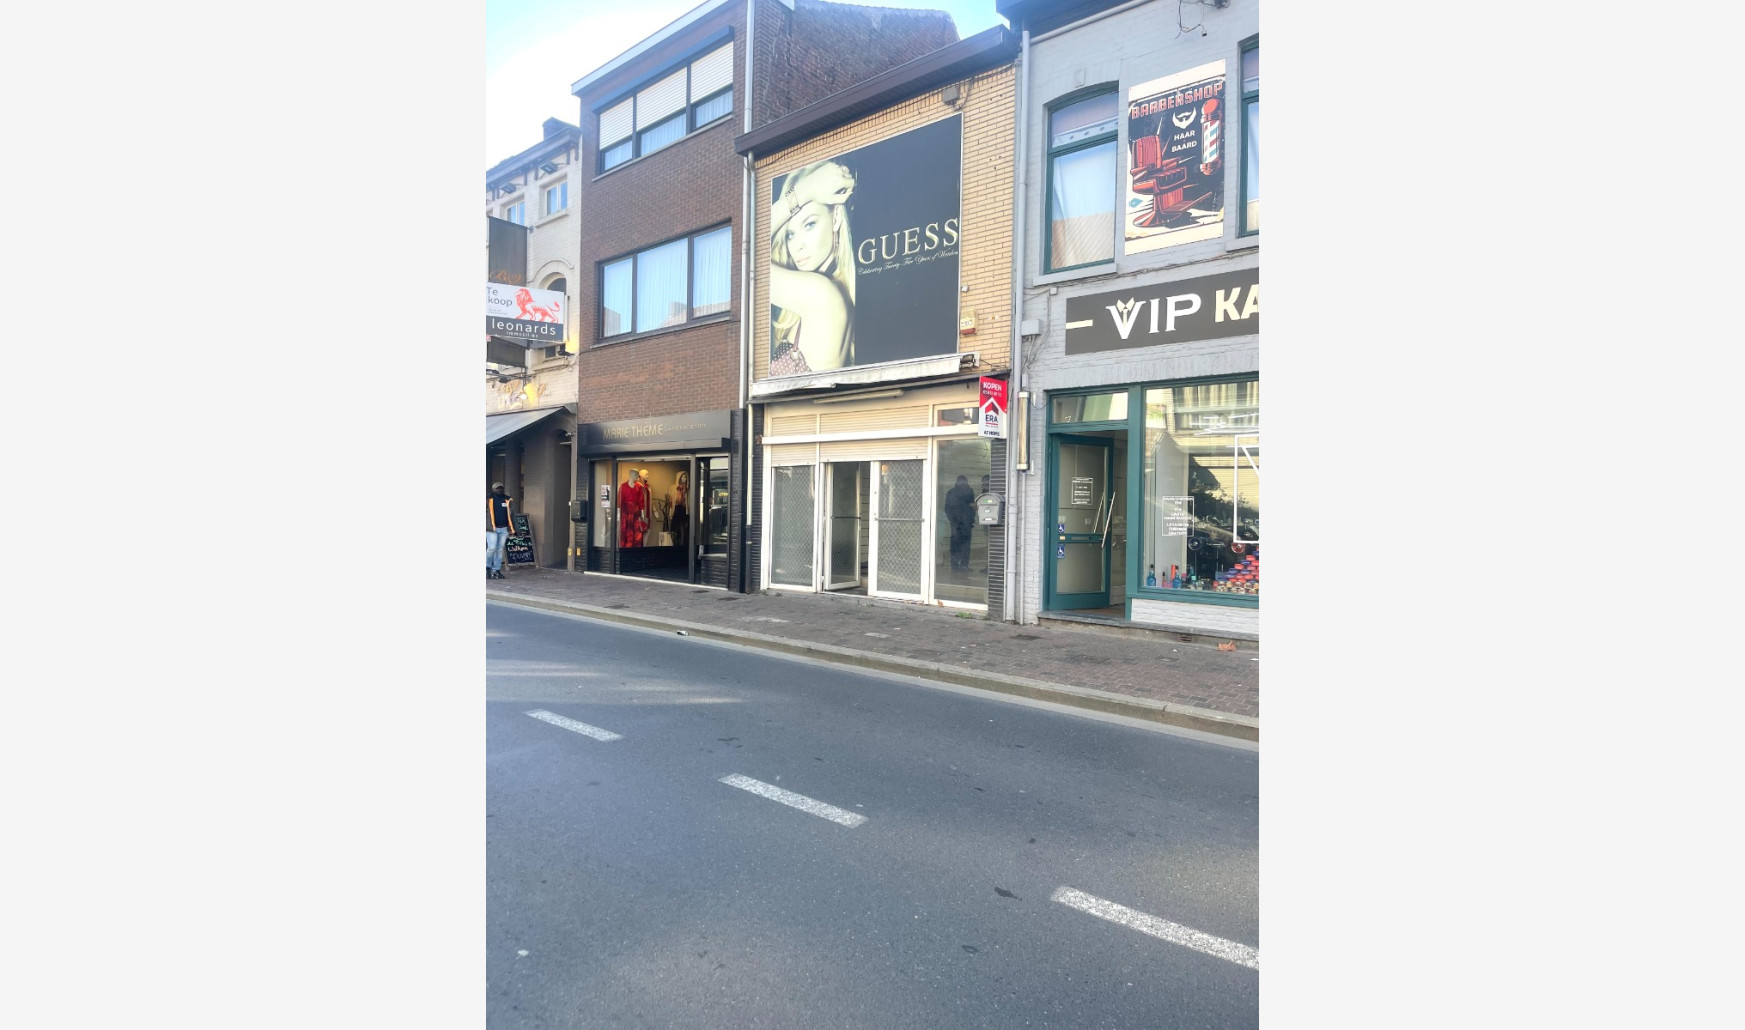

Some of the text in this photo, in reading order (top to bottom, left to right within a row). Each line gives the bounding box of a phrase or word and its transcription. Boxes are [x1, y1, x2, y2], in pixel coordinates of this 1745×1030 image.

[1131, 82, 1223, 120] BARBERSHOP
[1173, 130, 1195, 141] HAAR
[1171, 141, 1197, 153] BAARD
[858, 218, 958, 264] GUESS
[486, 287, 498, 295] Te
[488, 297, 512, 307] koop
[1105, 293, 1202, 340] VIP
[492, 318, 555, 335] leonards
[983, 382, 1002, 391] KOPEN
[985, 414, 998, 423] ERA
[603, 427, 630, 439] MARIE
